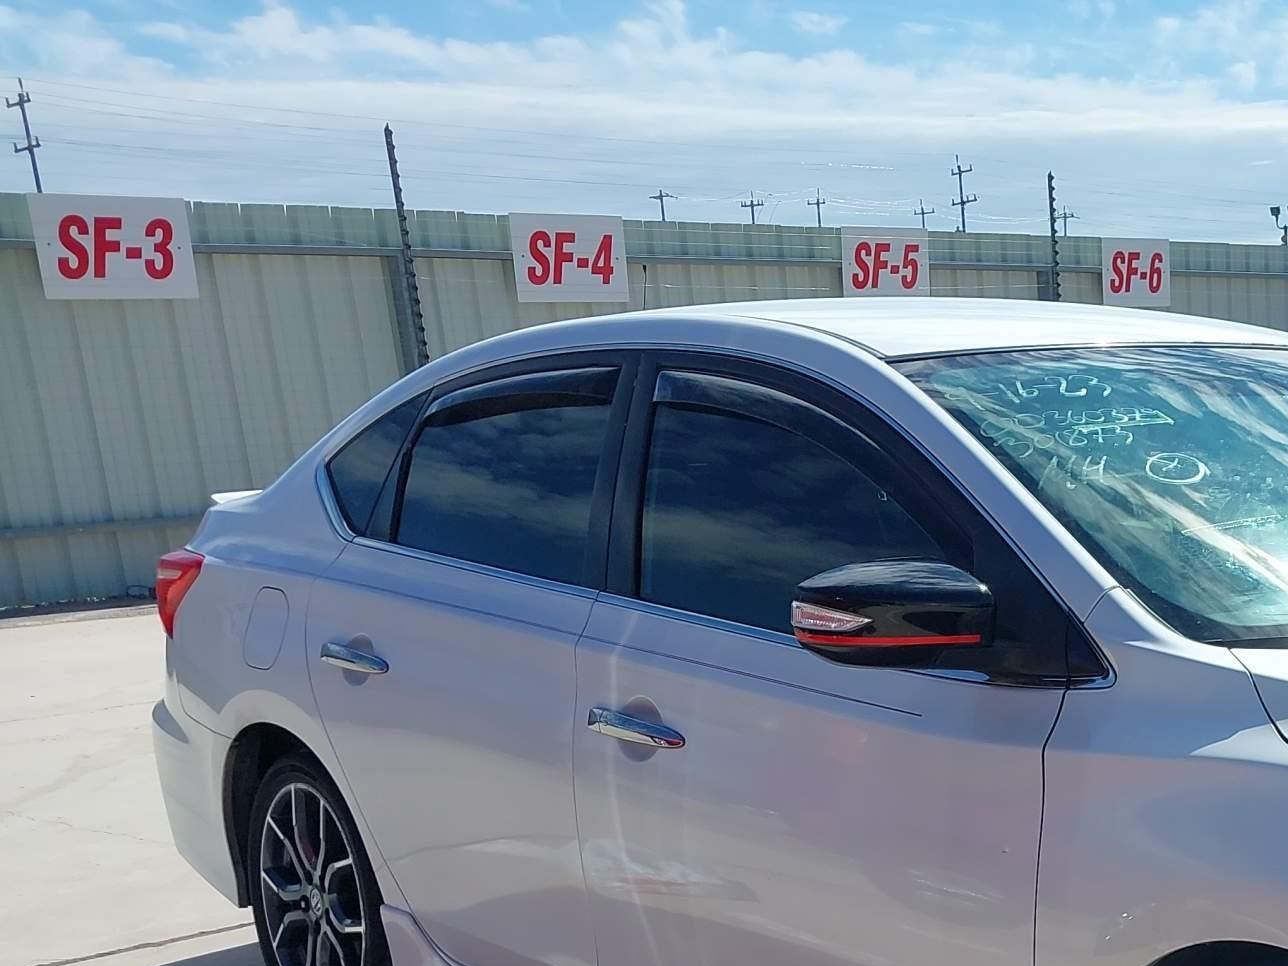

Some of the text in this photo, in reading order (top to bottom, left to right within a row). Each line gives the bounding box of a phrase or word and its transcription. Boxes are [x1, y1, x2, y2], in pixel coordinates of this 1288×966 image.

[56, 213, 176, 281] SF-3
[526, 230, 615, 287] SF-4
[851, 240, 920, 290] SF-5
[1109, 250, 1163, 294] SF-6
